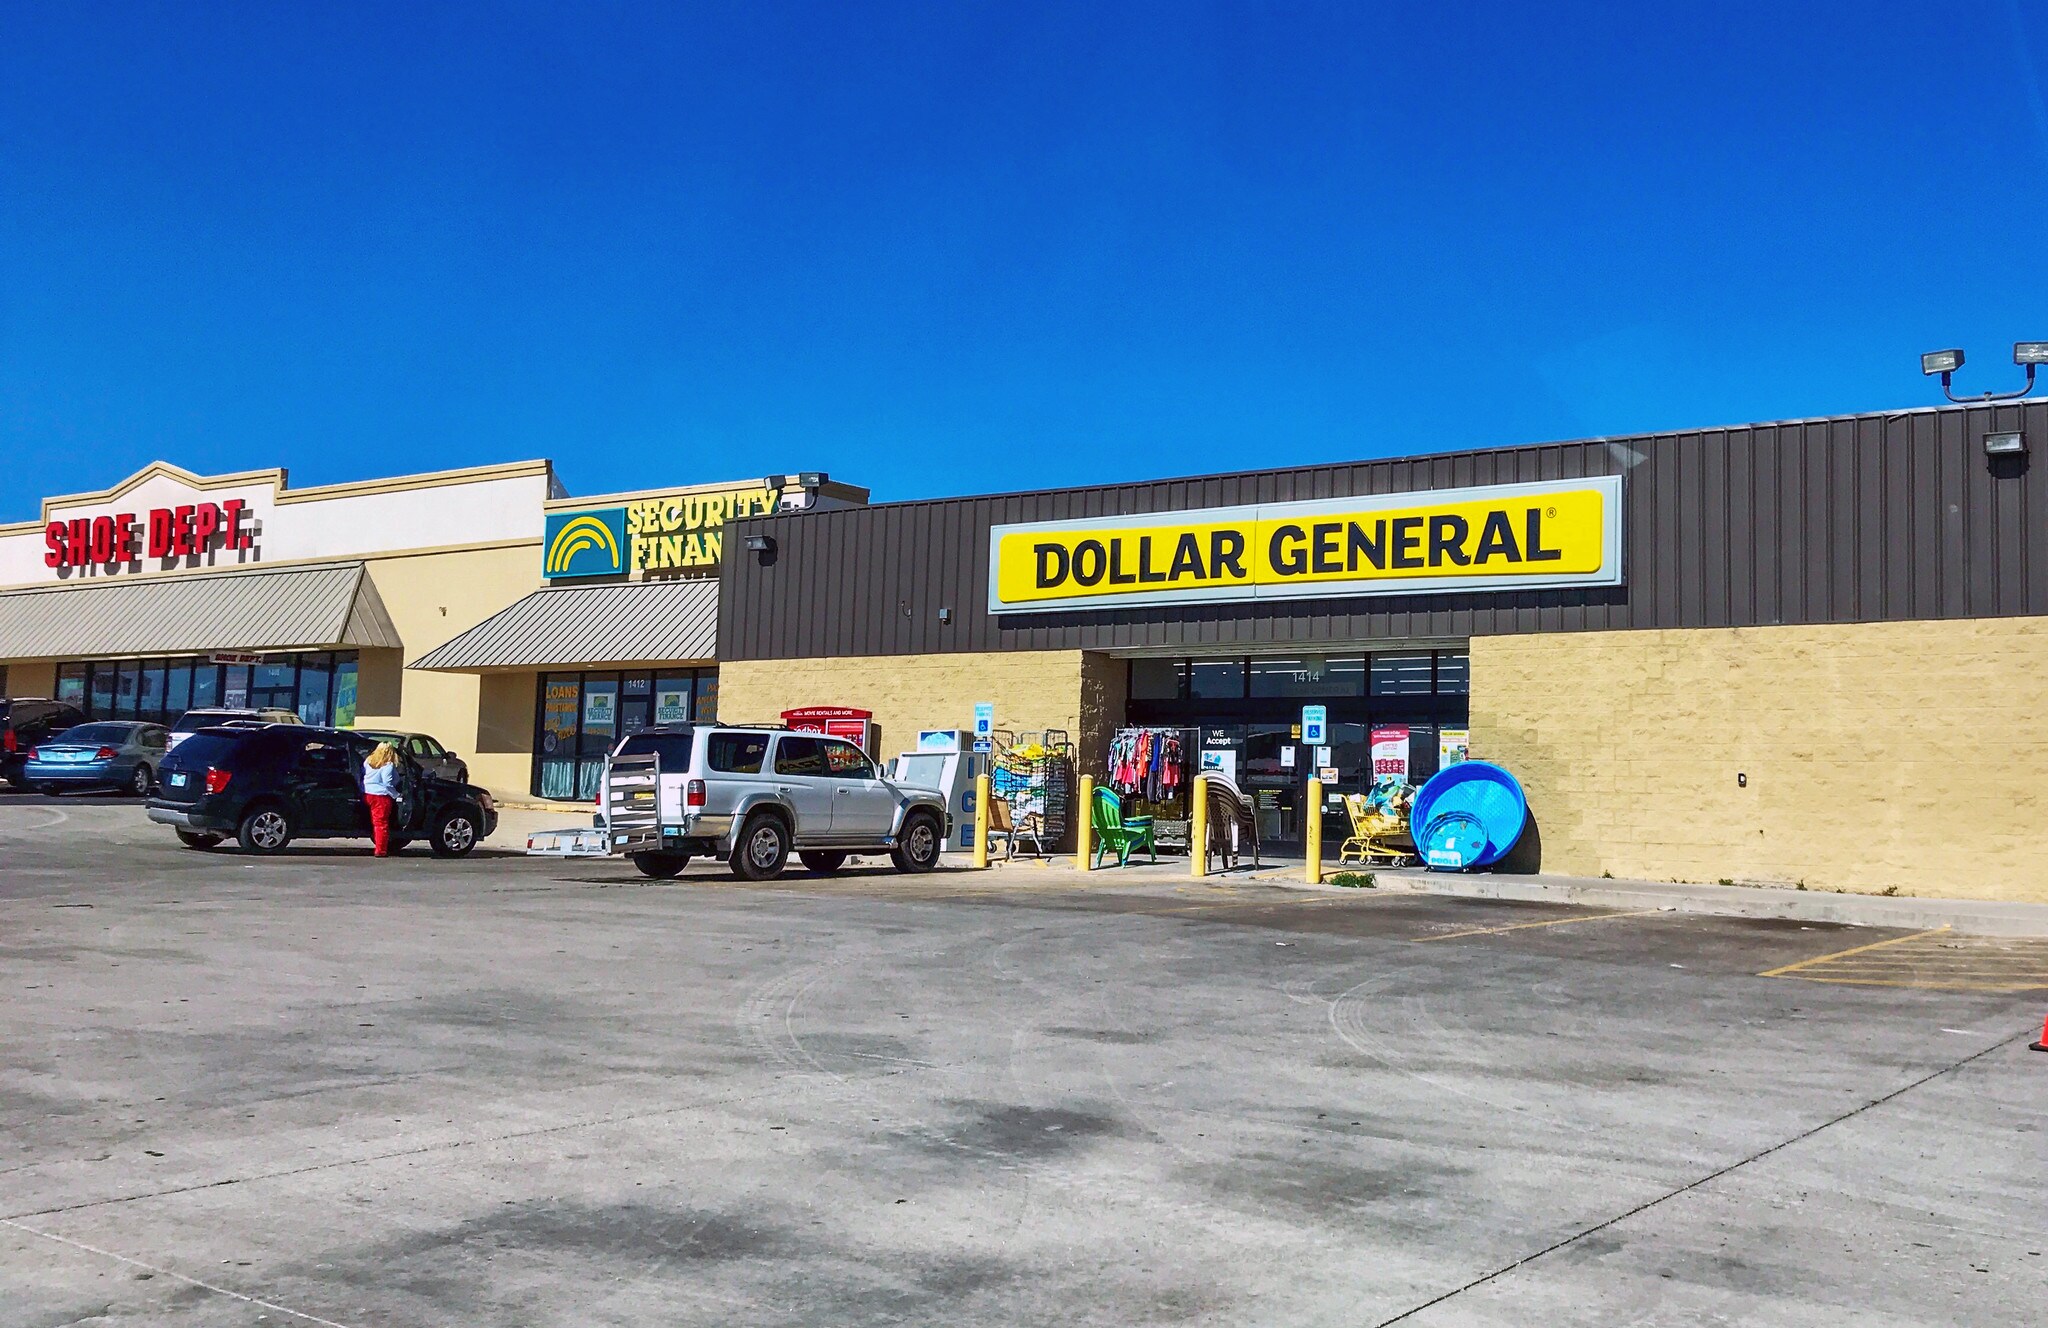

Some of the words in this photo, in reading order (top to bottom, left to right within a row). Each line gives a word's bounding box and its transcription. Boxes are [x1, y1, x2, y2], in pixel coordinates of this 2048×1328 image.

[627, 490, 778, 534] SECURITY
[45, 513, 136, 568] SHOE
[149, 499, 253, 558] DEPT.
[631, 531, 723, 570] FINAN
[1034, 530, 1247, 589] DOLLAR
[1269, 508, 1562, 576] GENERAL
[1292, 671, 1320, 683] 1414
[628, 679, 645, 689] 1412
[545, 686, 579, 699] LOANS
[658, 706, 685, 715] SECURITY
[659, 712, 684, 720] FINANCE
[1212, 729, 1224, 737] WE
[1206, 737, 1231, 746] Accept
[1431, 857, 1459, 865] POOLS
